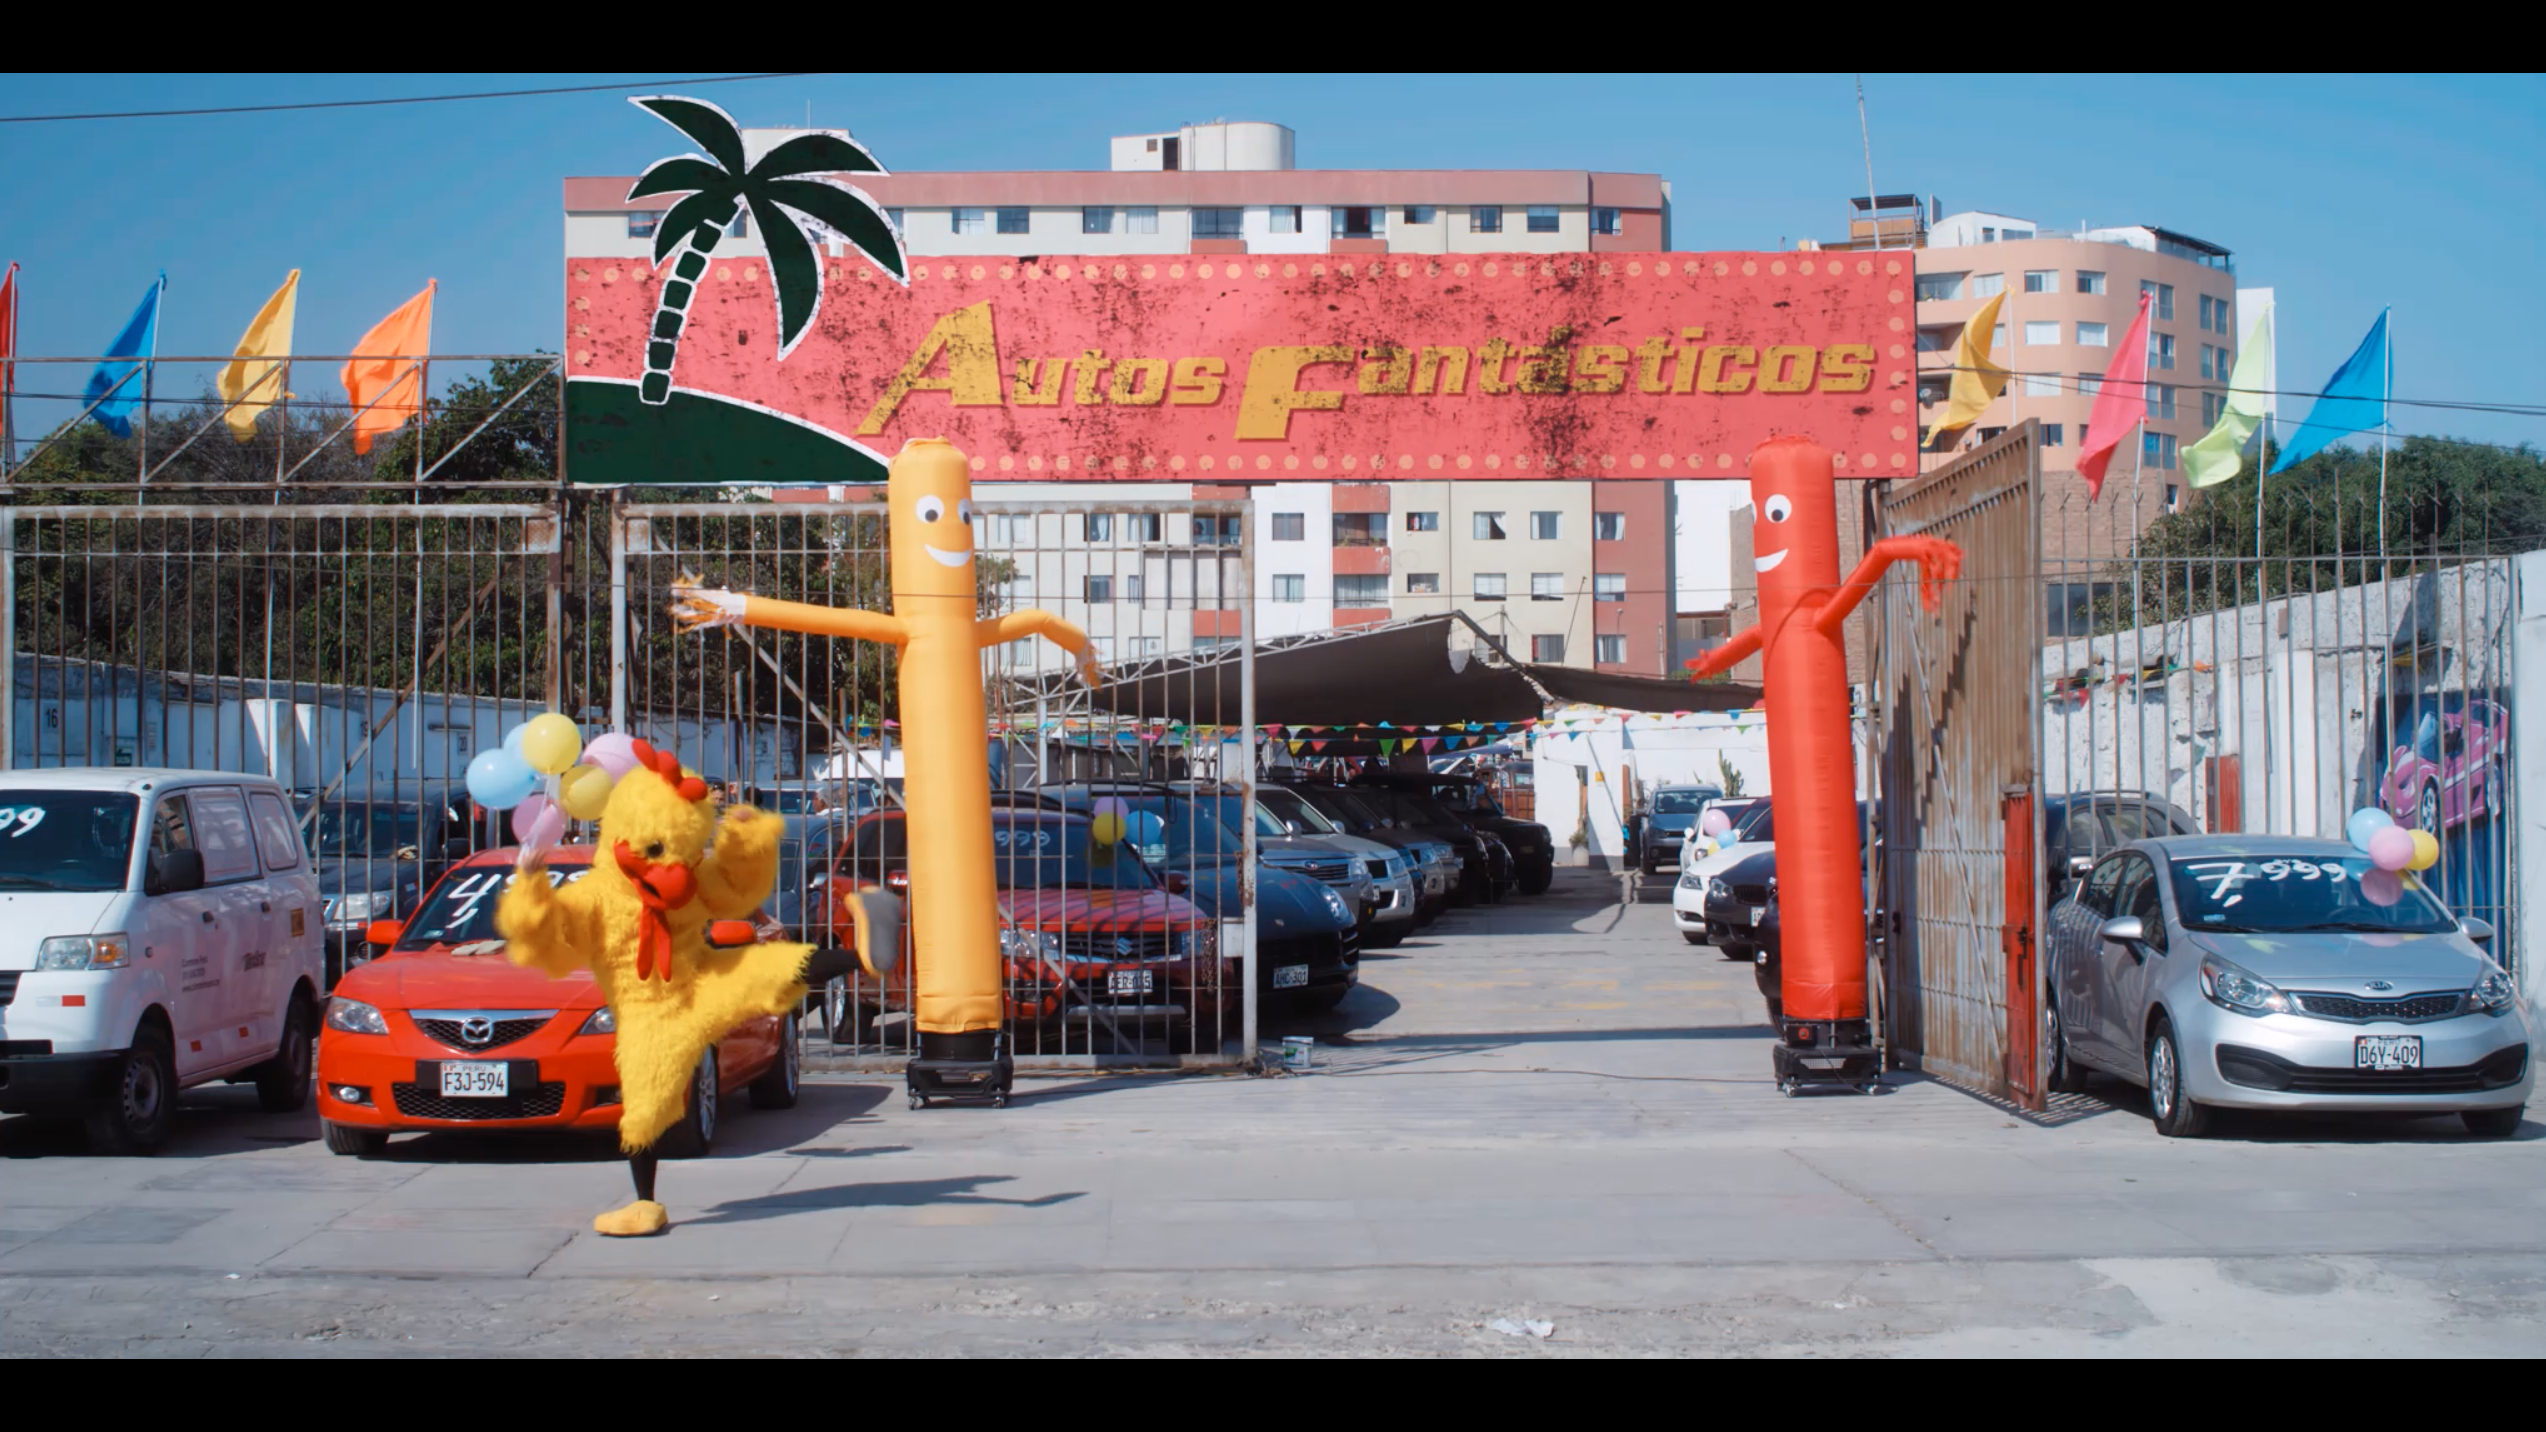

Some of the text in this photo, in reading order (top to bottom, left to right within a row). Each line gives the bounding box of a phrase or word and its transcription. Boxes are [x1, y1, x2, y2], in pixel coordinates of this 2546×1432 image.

[855, 300, 1228, 436] Autos
[46, 708, 58, 728] 16
[2186, 862, 2348, 908] 7,999
[2359, 1045, 2418, 1064] D6Y-409
[463, 1064, 486, 1072] PERU
[444, 1072, 504, 1091] F3J-594
